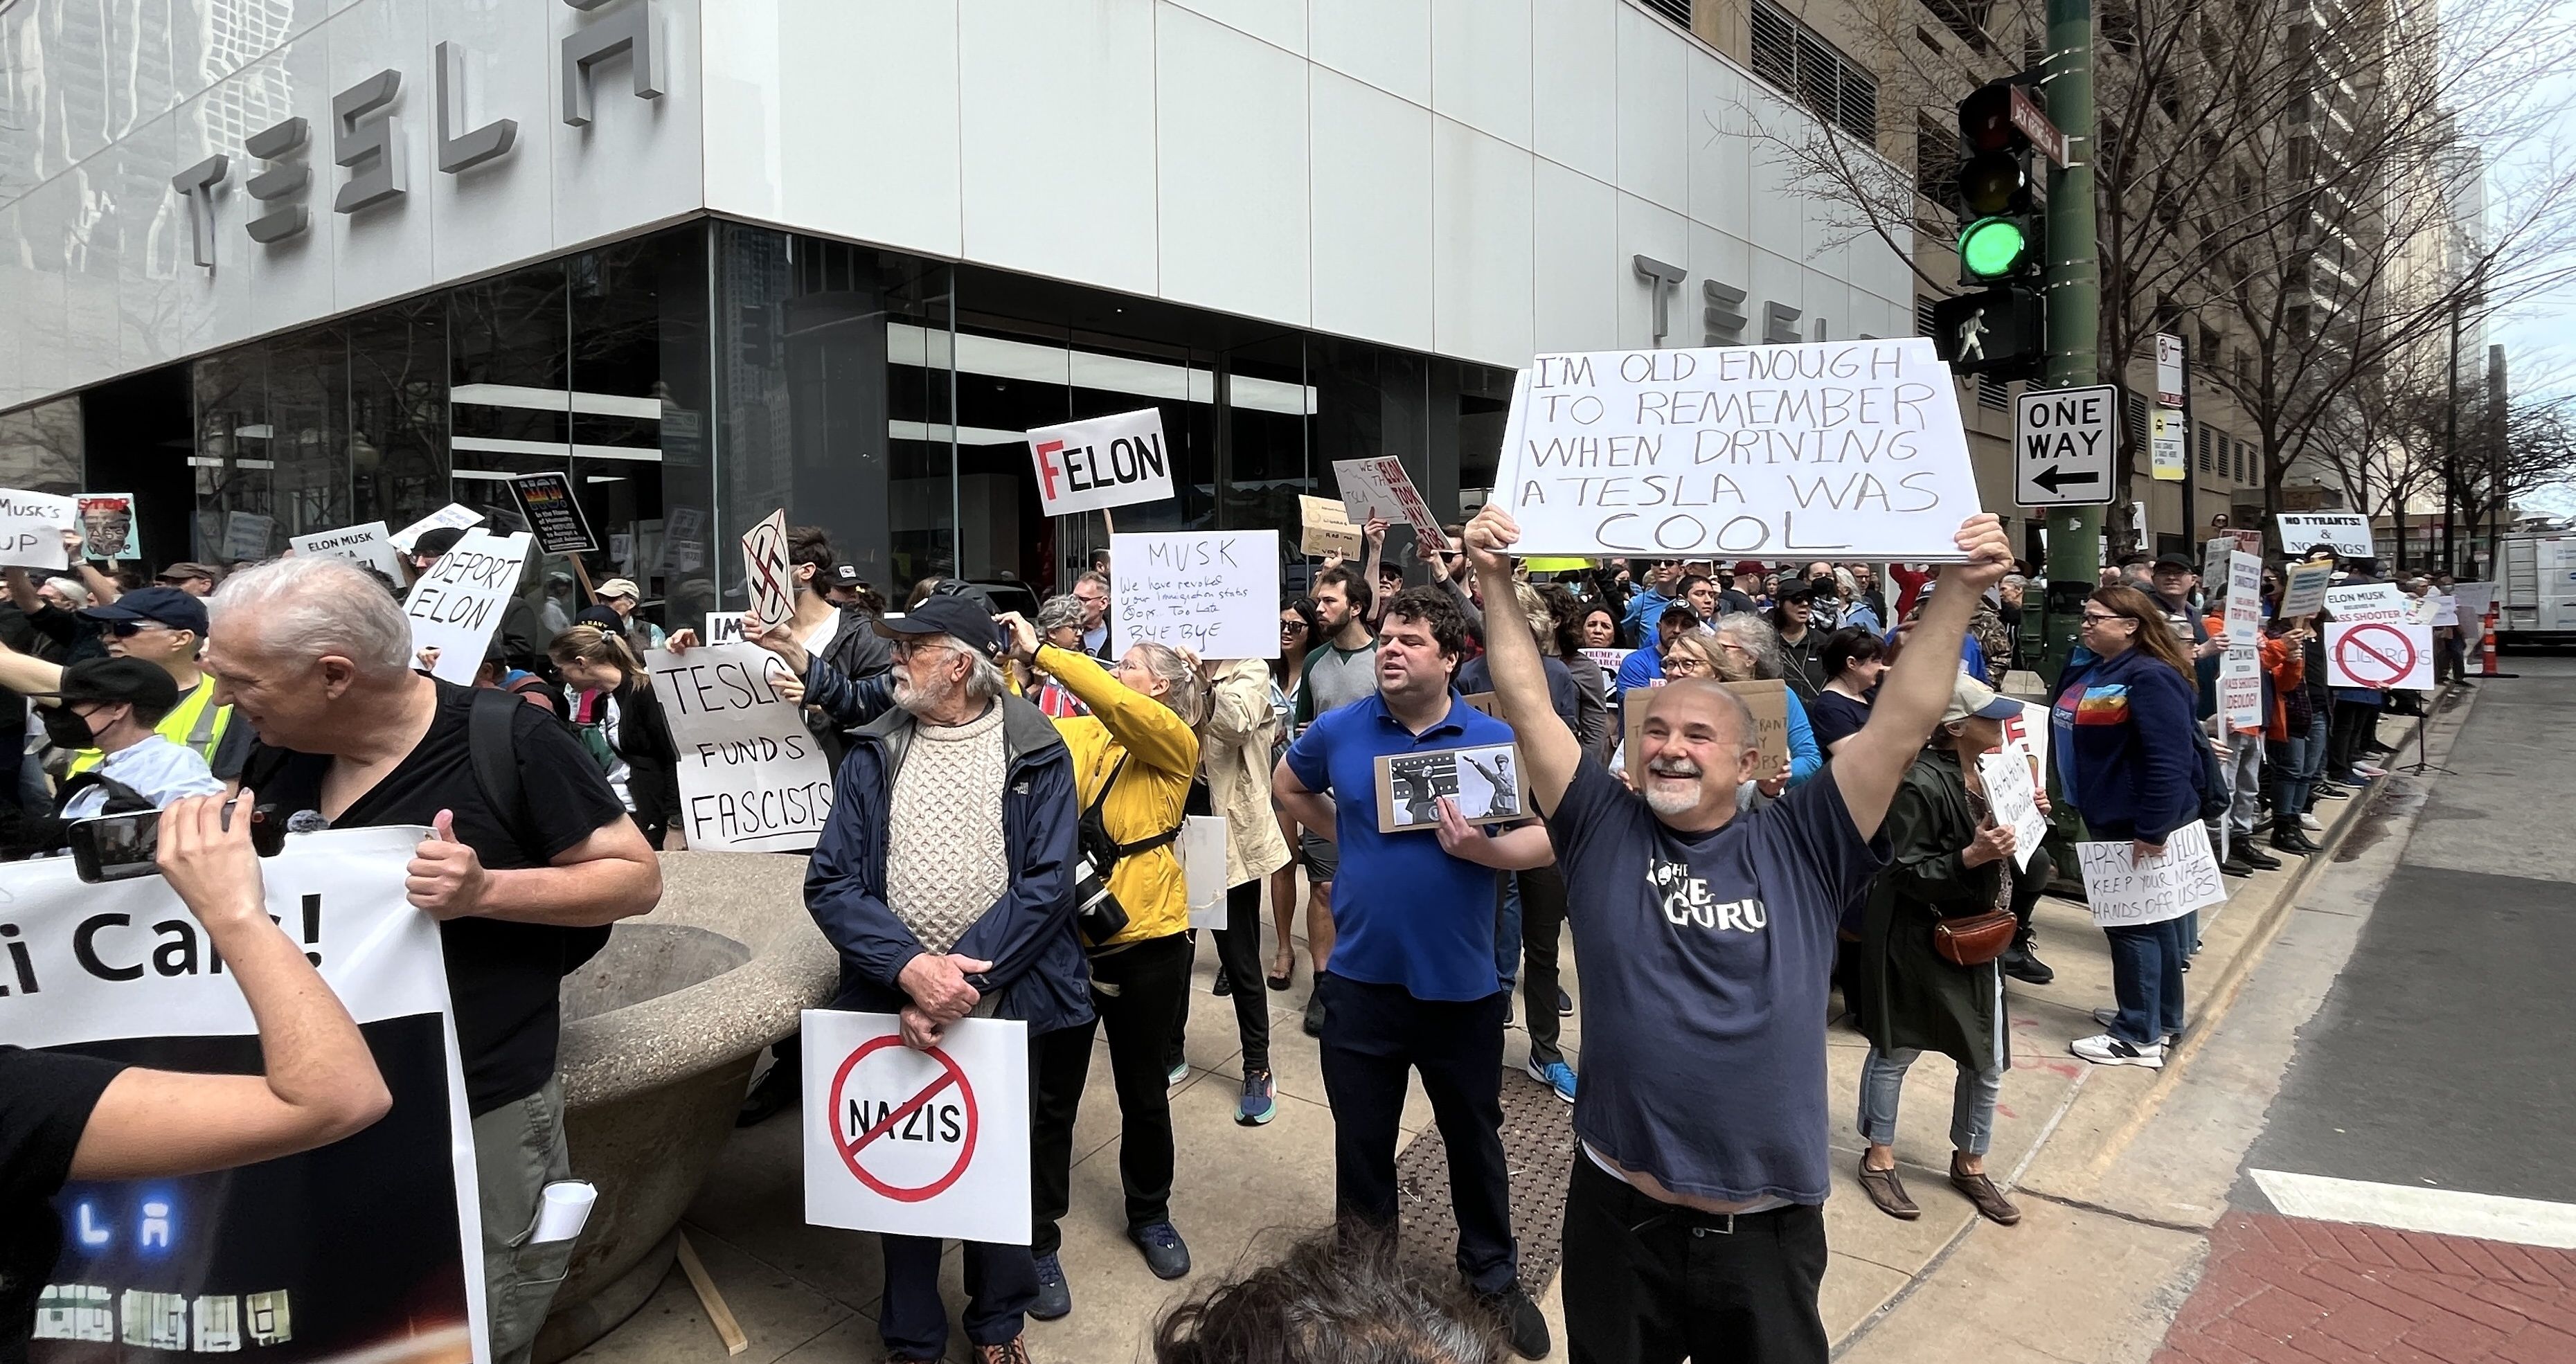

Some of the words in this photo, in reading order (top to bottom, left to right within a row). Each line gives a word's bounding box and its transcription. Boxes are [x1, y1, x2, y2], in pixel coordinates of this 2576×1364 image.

[172, 0, 663, 267] TESLA
[1633, 254, 1879, 346] TES
[1535, 355, 1596, 389] I'M
[1620, 352, 1696, 383] OLD
[1719, 346, 1901, 382] ENOUGH
[1542, 394, 1604, 424] TO
[1638, 383, 1935, 429] REMEMBER
[2030, 397, 2101, 428] ONE
[1529, 435, 1663, 469] WHEN
[1694, 428, 1918, 465] DRIVING
[2027, 429, 2103, 459] WAY
[1036, 433, 1164, 501] FELON
[1359, 460, 1372, 472] WE
[519, 478, 567, 510] NO!
[1391, 485, 1422, 506] TOOK
[1522, 480, 1546, 508] A
[1557, 474, 1746, 508] TESLA
[1787, 472, 1939, 512] WAS
[1595, 511, 1852, 551] COOL
[2302, 517, 2361, 526] TYRANTS!
[2320, 530, 2332, 539] &
[307, 540, 339, 552] ELON
[341, 532, 374, 546] MUSK
[1149, 539, 1237, 571] MUSK
[1418, 528, 1445, 550] JOB
[2291, 541, 2312, 551] NO
[431, 552, 521, 589] DEPORT
[1120, 577, 1139, 594] We
[1148, 576, 1170, 590] have
[1178, 575, 1223, 590] revoked
[409, 589, 495, 631] ELON
[1168, 606, 1190, 616] Too
[2327, 594, 2355, 603] ELON
[2358, 591, 2386, 601] MUSK
[2334, 613, 2352, 622] ASS
[2354, 610, 2401, 622] SHOOTER
[1127, 625, 1171, 643] BYE
[1179, 622, 1222, 652] BYE
[696, 735, 805, 767] FUNDS
[691, 781, 832, 840] FASCISTS
[2093, 876, 2132, 897] KEEP
[2140, 872, 2172, 893] YOUR
[2175, 855, 2212, 883] NAZI
[1664, 891, 1766, 933] GURU
[2093, 901, 2142, 921] HANDS
[849, 1099, 960, 1142] NAZIS
